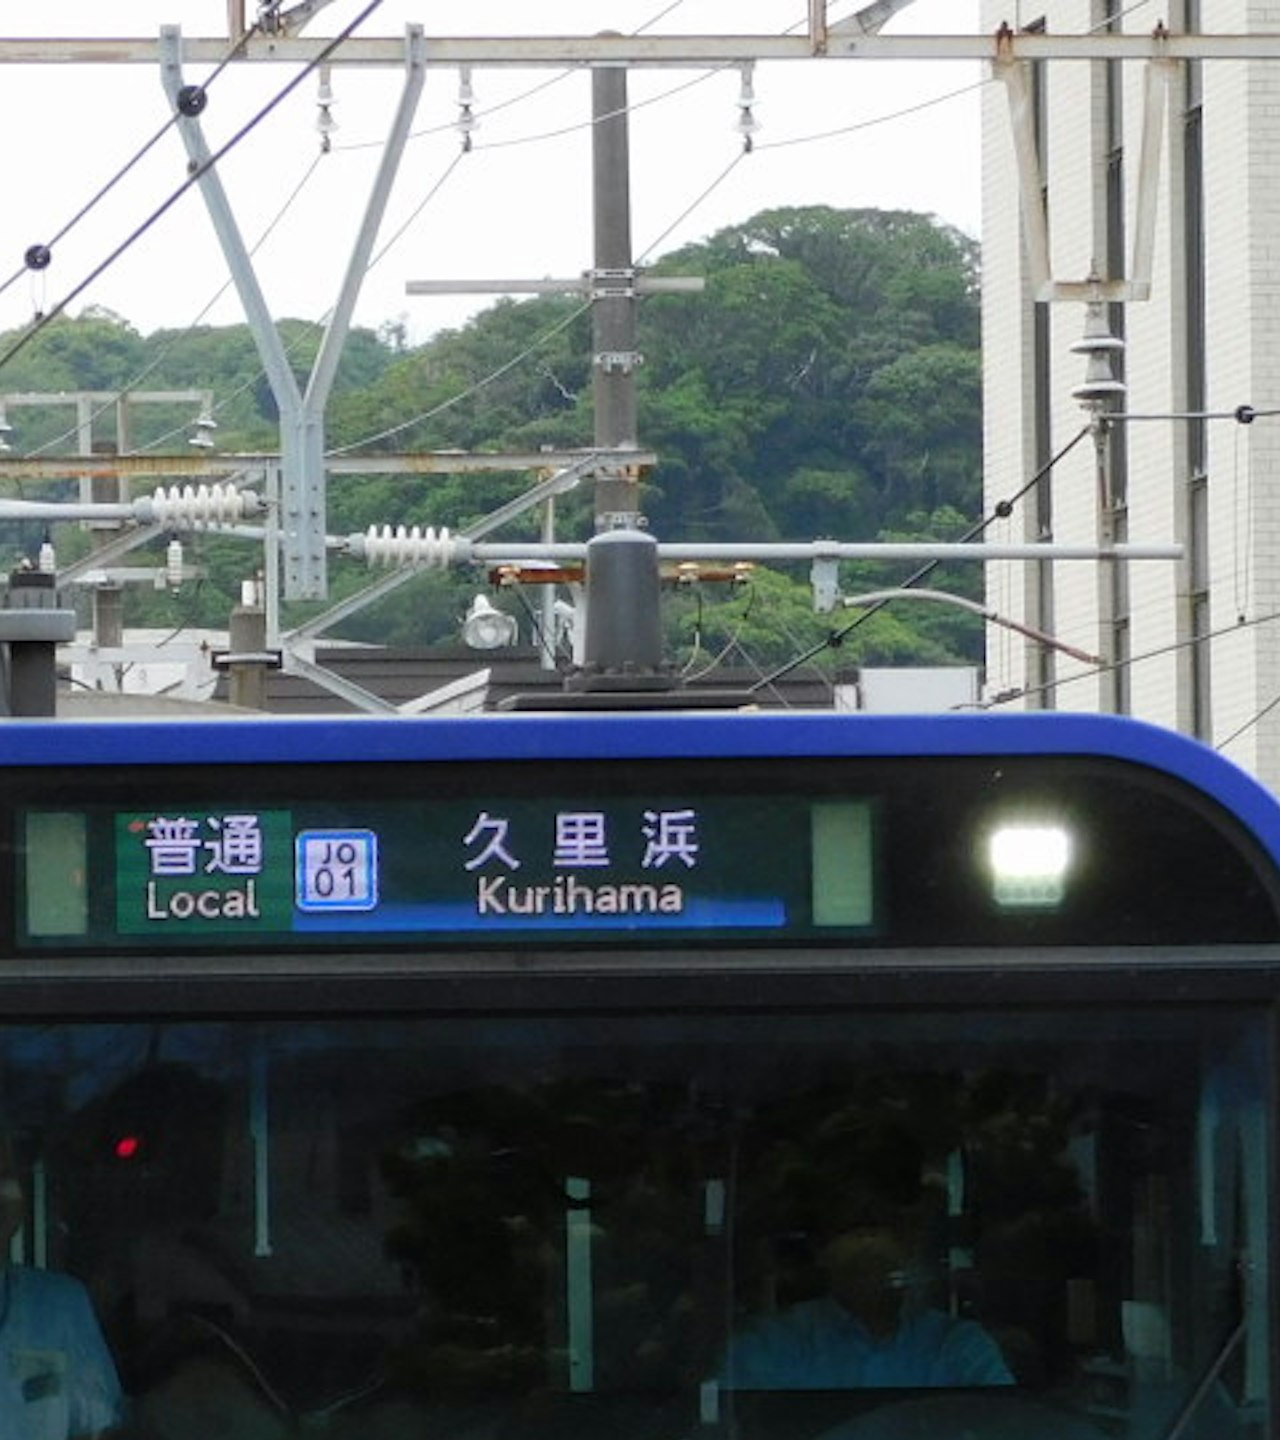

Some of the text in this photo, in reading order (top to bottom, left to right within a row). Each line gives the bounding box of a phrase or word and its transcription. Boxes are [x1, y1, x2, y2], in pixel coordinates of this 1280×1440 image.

[144, 816, 263, 876] 普通
[320, 842, 358, 866] JO
[463, 809, 699, 871] 久里浜
[147, 882, 260, 918] Local
[314, 868, 360, 899] 01
[478, 876, 683, 916] Kurihama
